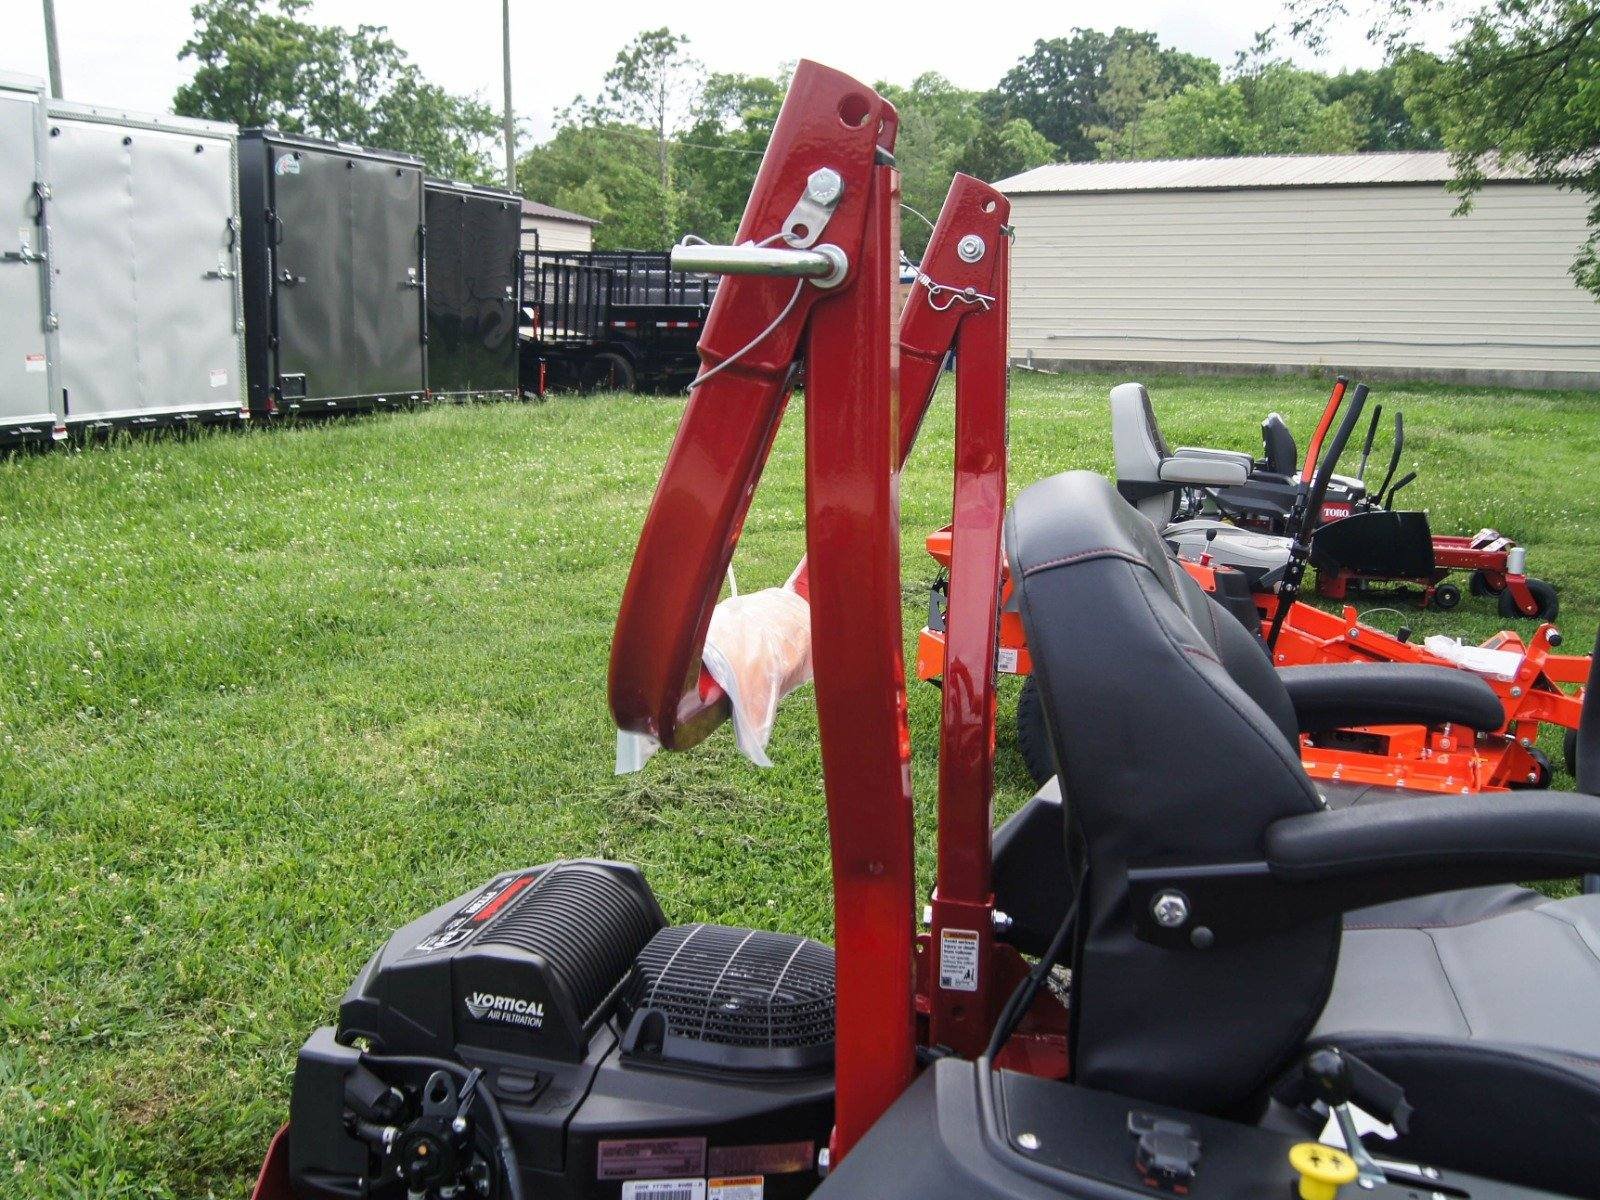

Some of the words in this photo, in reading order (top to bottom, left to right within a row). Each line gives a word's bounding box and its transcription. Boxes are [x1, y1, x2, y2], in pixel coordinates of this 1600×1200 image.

[1323, 508, 1350, 518] TORO
[472, 992, 545, 1017] VORTICAL
[487, 1009, 501, 1020] AIR
[501, 1012, 543, 1028] FILTRATION
